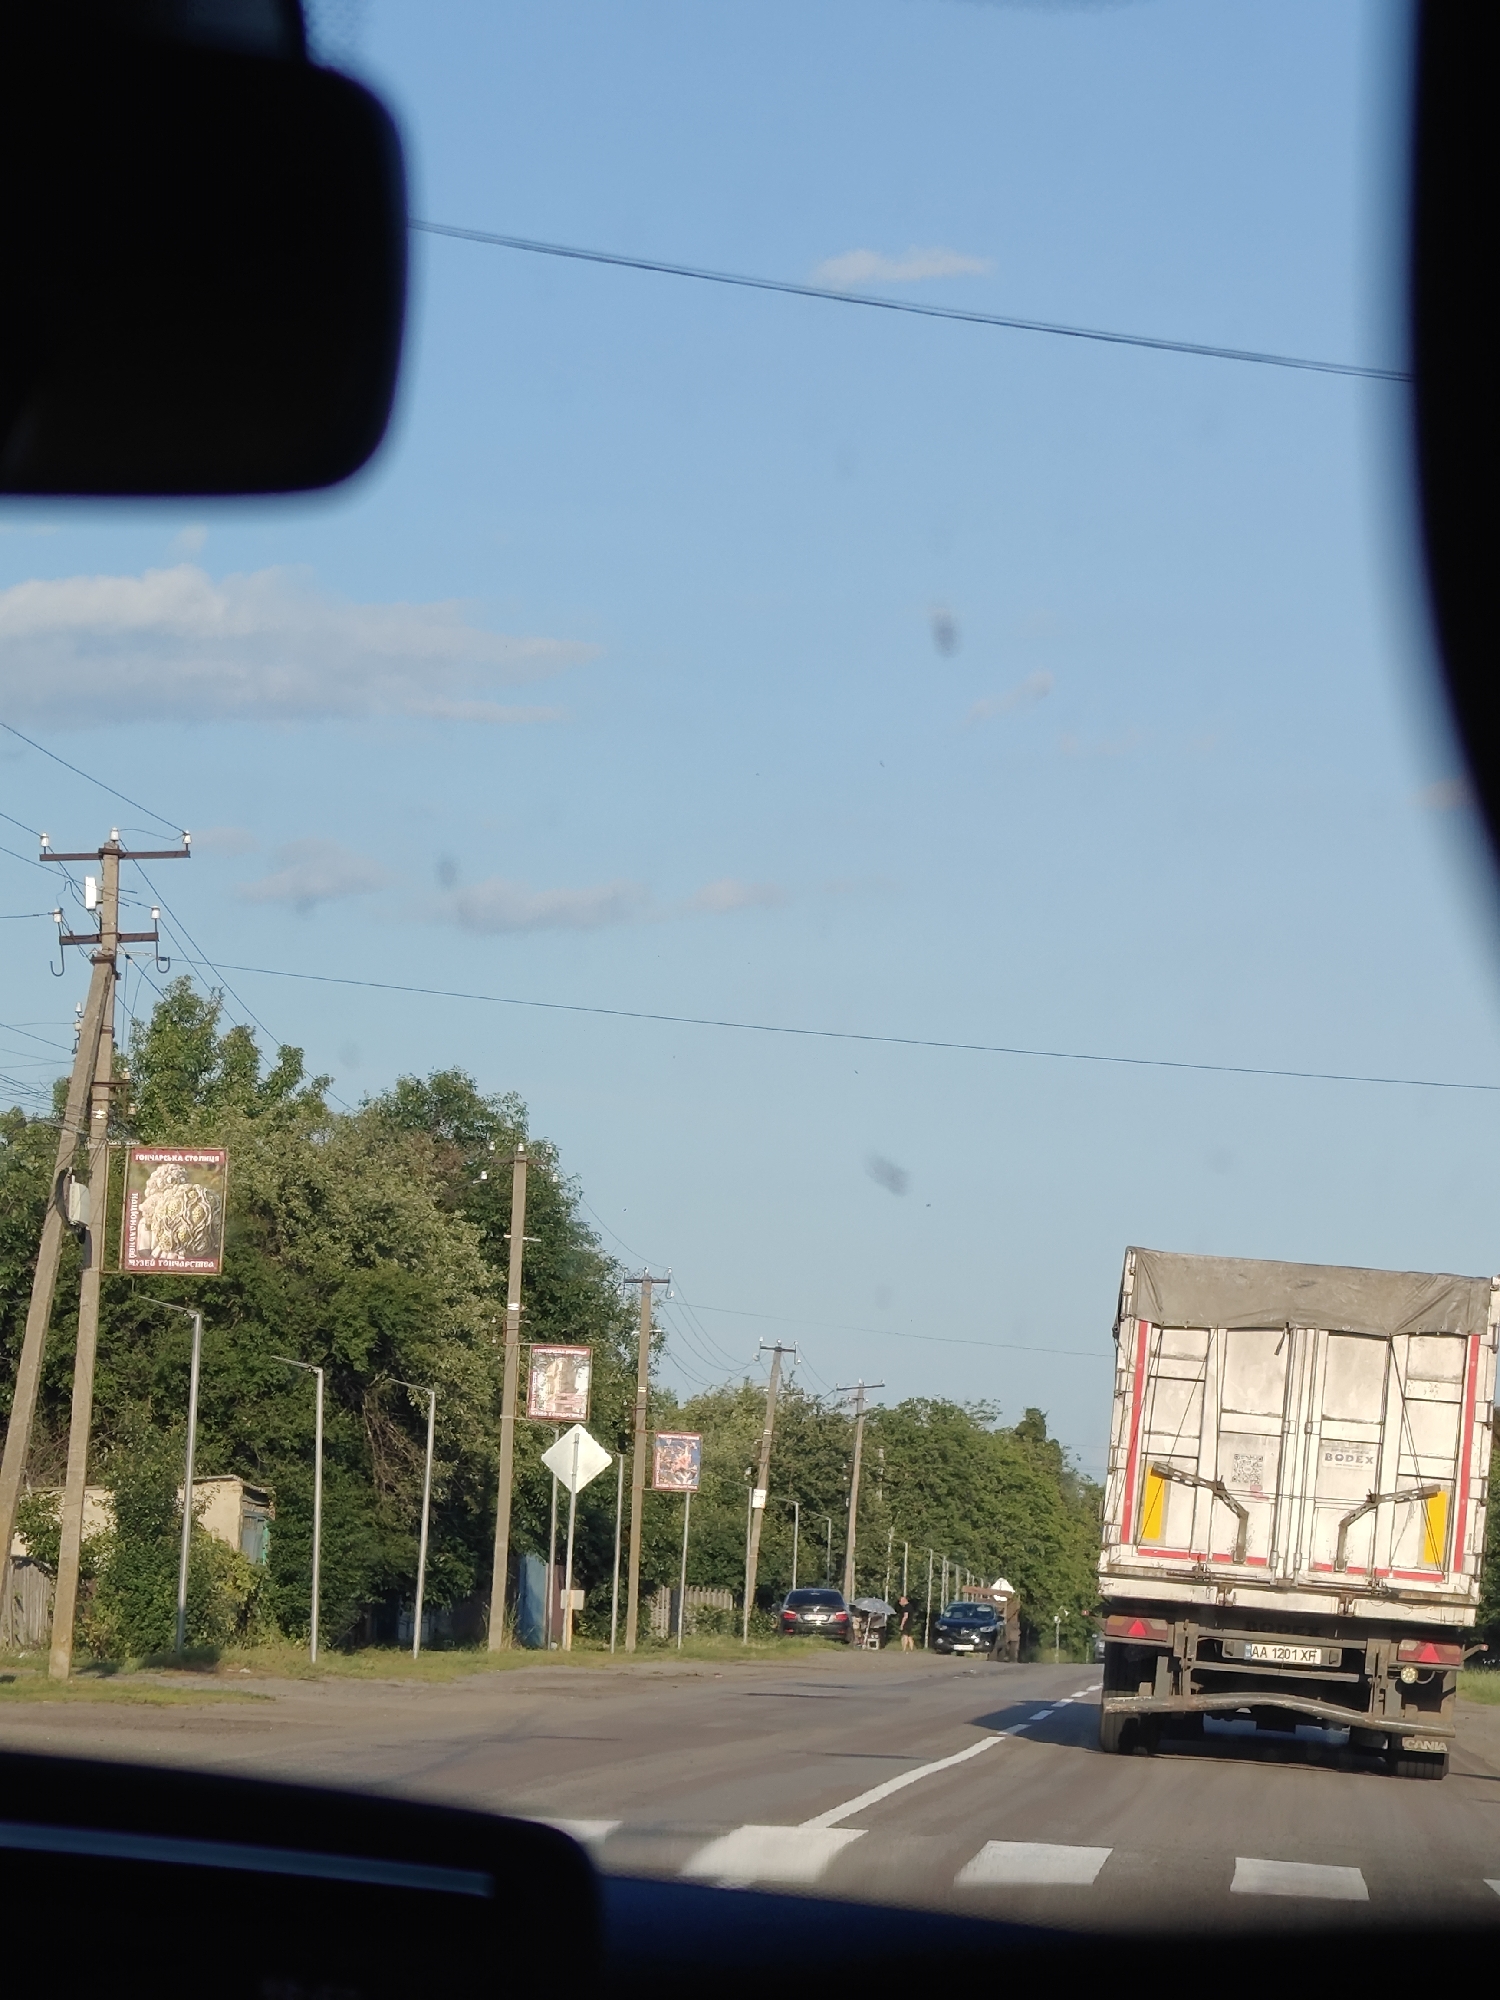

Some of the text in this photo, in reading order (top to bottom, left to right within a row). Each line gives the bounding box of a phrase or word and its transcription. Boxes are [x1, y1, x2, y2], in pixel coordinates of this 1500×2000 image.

[135, 1154, 220, 1163] ГОНЧАРСЬКА СТОЛИЦЯ
[128, 1259, 156, 1267] МУЗЕЙ
[1324, 1453, 1374, 1464] BODEX
[1252, 1645, 1268, 1658] AA
[1272, 1647, 1298, 1660] 1201
[1402, 1739, 1448, 1752] CANIA
